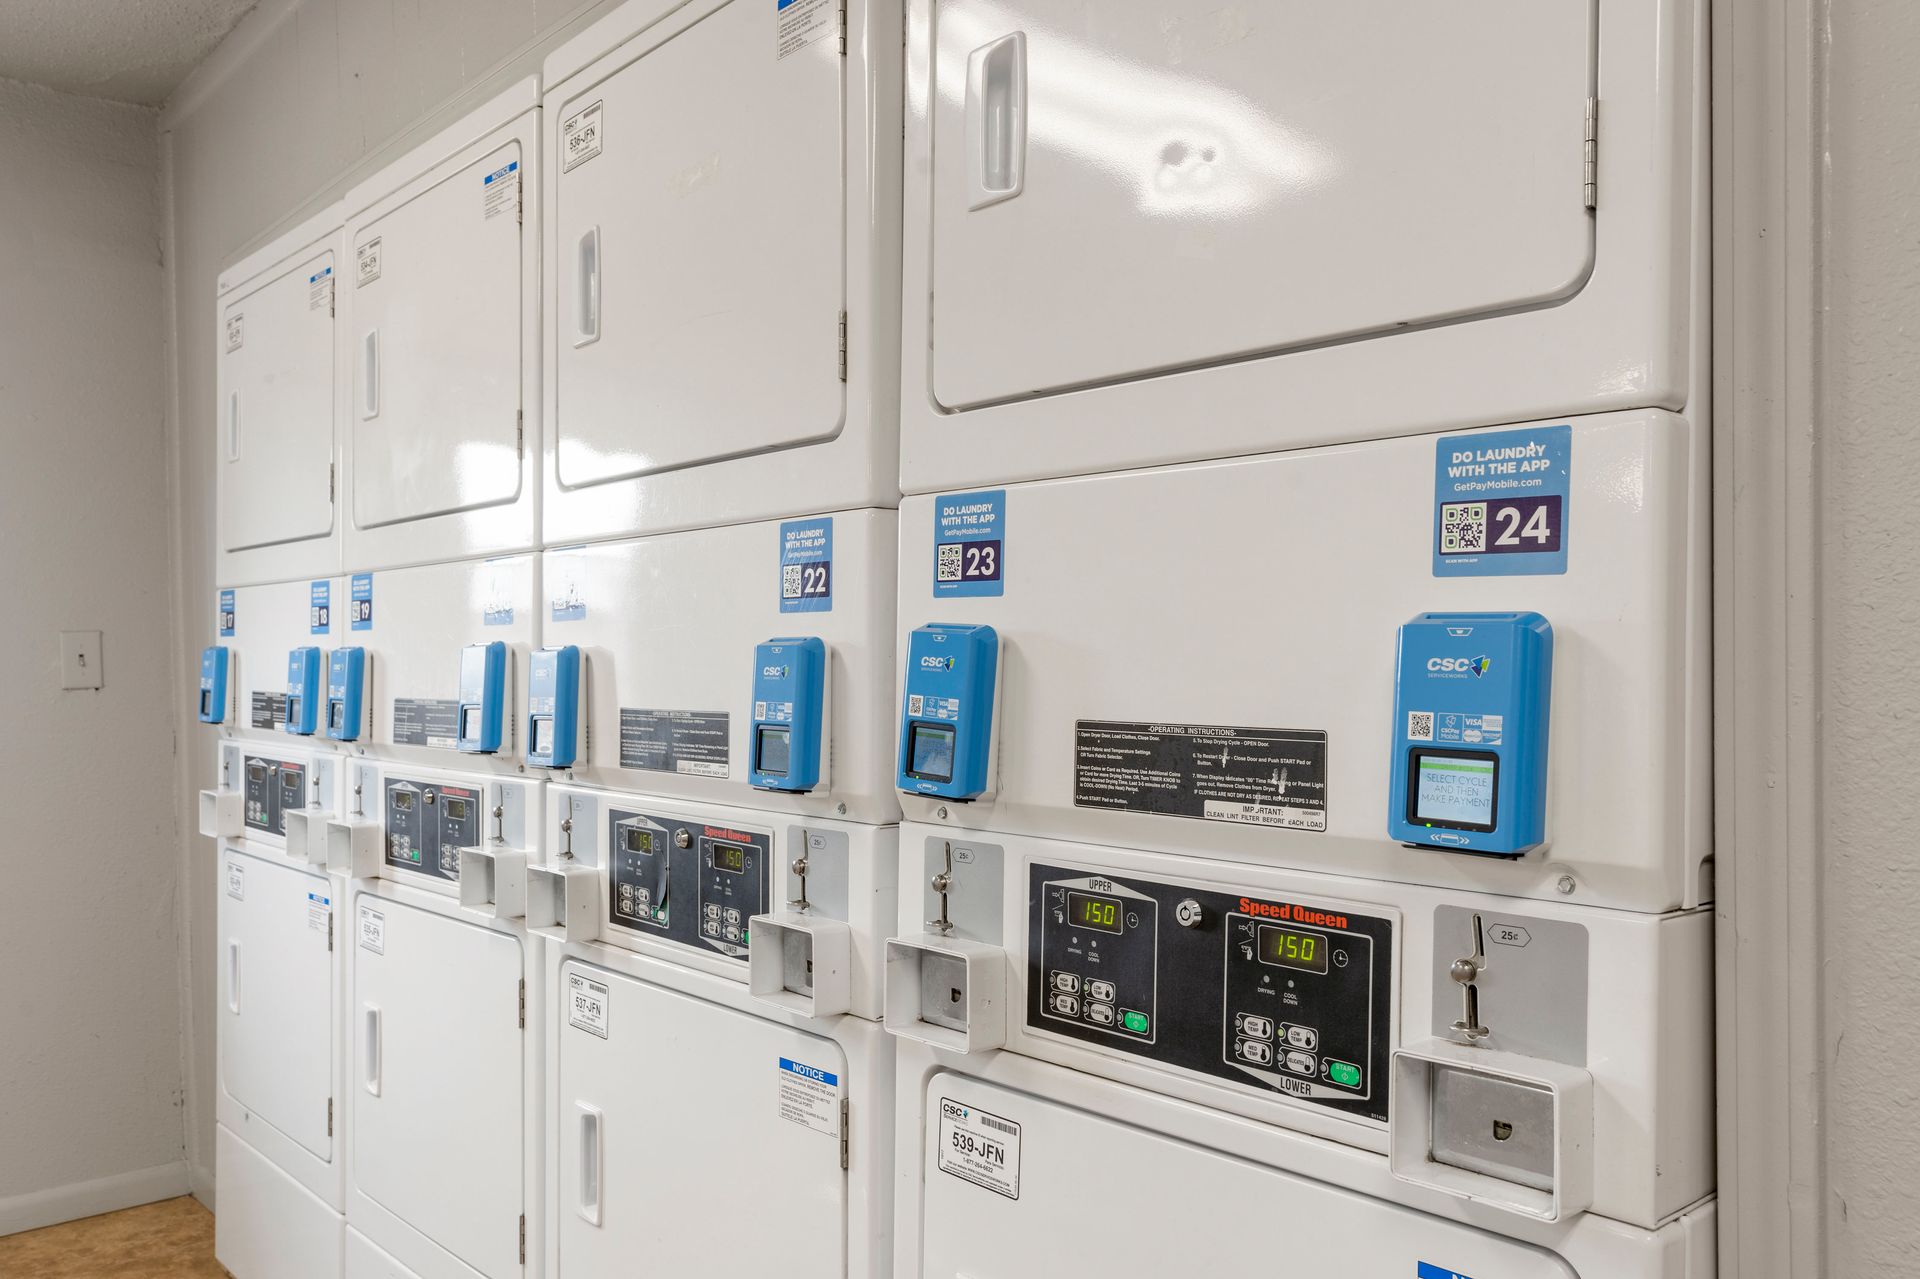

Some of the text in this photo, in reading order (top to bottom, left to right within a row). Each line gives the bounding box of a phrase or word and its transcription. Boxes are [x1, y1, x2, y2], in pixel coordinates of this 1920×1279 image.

[1452, 444, 1546, 464] DO LAUNDRY
[1448, 460, 1550, 478] WITH THE APP
[1454, 478, 1542, 492] GetPayMobile.com
[944, 504, 992, 515] DO LAUNDRY
[941, 514, 995, 526] WITH THE APP
[1494, 505, 1550, 546] 24
[796, 529, 824, 539] LAUNDRY
[785, 540, 800, 549] WITH
[814, 538, 825, 546] APP
[966, 546, 995, 576] 23
[804, 567, 826, 593] 22
[320, 608, 328, 624] 18
[361, 602, 370, 620] 19
[227, 614, 233, 628] 17
[920, 656, 944, 668] CSC
[1426, 657, 1469, 672] CSC
[764, 666, 780, 676] CSC
[1465, 718, 1482, 726] VISA
[1426, 774, 1488, 788] SELECT CYCLE
[1434, 785, 1478, 796] AND THEN
[1422, 794, 1490, 808] MAKE PAYMENT
[1241, 814, 1260, 822] FILTER
[704, 826, 752, 842] Speed Queen
[726, 850, 741, 867] 150
[1088, 878, 1112, 892] UPPER
[1086, 901, 1114, 925] 150
[1240, 898, 1347, 929] Speed Queen
[1278, 934, 1315, 961] 150
[1258, 986, 1275, 996] DRYING
[1284, 992, 1297, 1000] COOL
[1283, 998, 1298, 1006] DOWN
[1291, 1035, 1302, 1043] TEMP
[792, 1063, 824, 1081] NOTICE
[1335, 1063, 1355, 1073] START
[1280, 1077, 1312, 1095] LOWER
[943, 1104, 962, 1116] CSC
[953, 1132, 1004, 1164] 539-JFN
